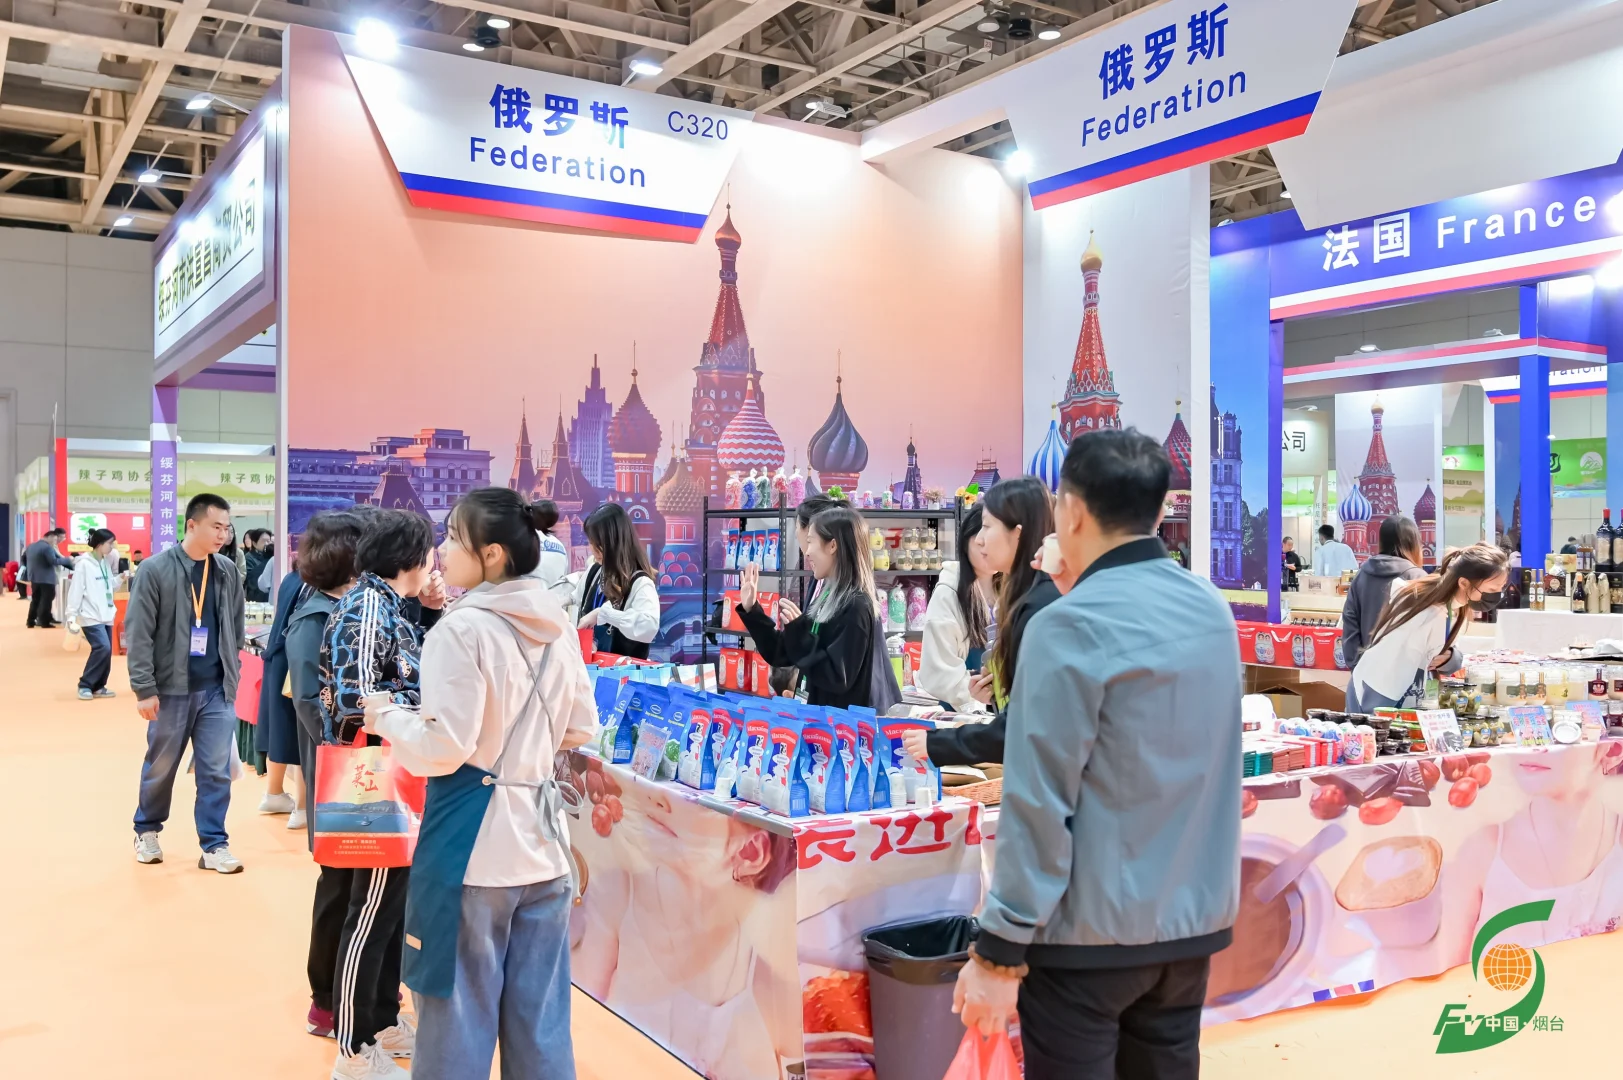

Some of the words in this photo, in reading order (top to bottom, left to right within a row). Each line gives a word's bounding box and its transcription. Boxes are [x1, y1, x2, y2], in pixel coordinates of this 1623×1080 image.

[1098, 2, 1229, 100] 俄罗斯
[489, 83, 629, 149] 俄罗斯
[667, 110, 729, 141] C320
[1081, 70, 1246, 148] Federation
[470, 136, 646, 188] Federation
[1321, 211, 1411, 272] 法国
[1437, 194, 1597, 249] France
